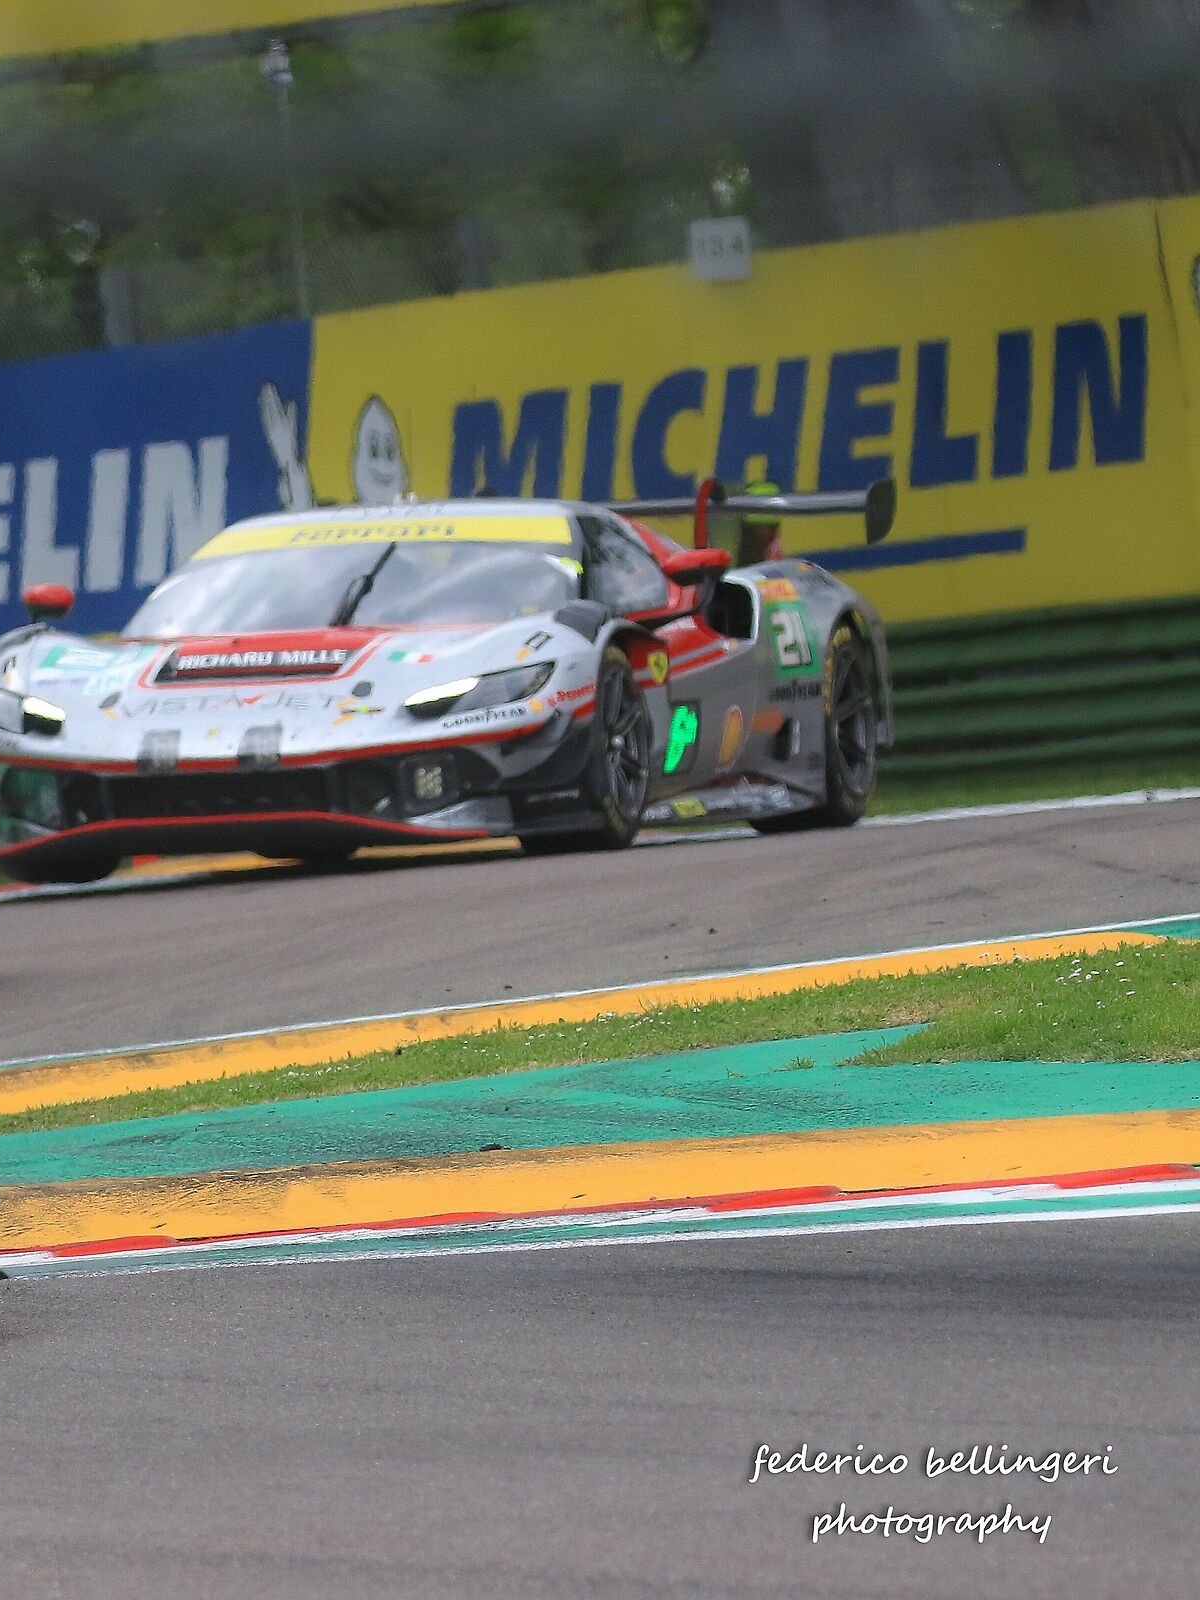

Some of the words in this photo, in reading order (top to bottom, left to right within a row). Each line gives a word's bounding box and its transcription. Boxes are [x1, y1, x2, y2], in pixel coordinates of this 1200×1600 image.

[449, 314, 1148, 500] MICHELIN
[178, 650, 273, 670] RICHARD
[279, 648, 348, 666] MILLE
